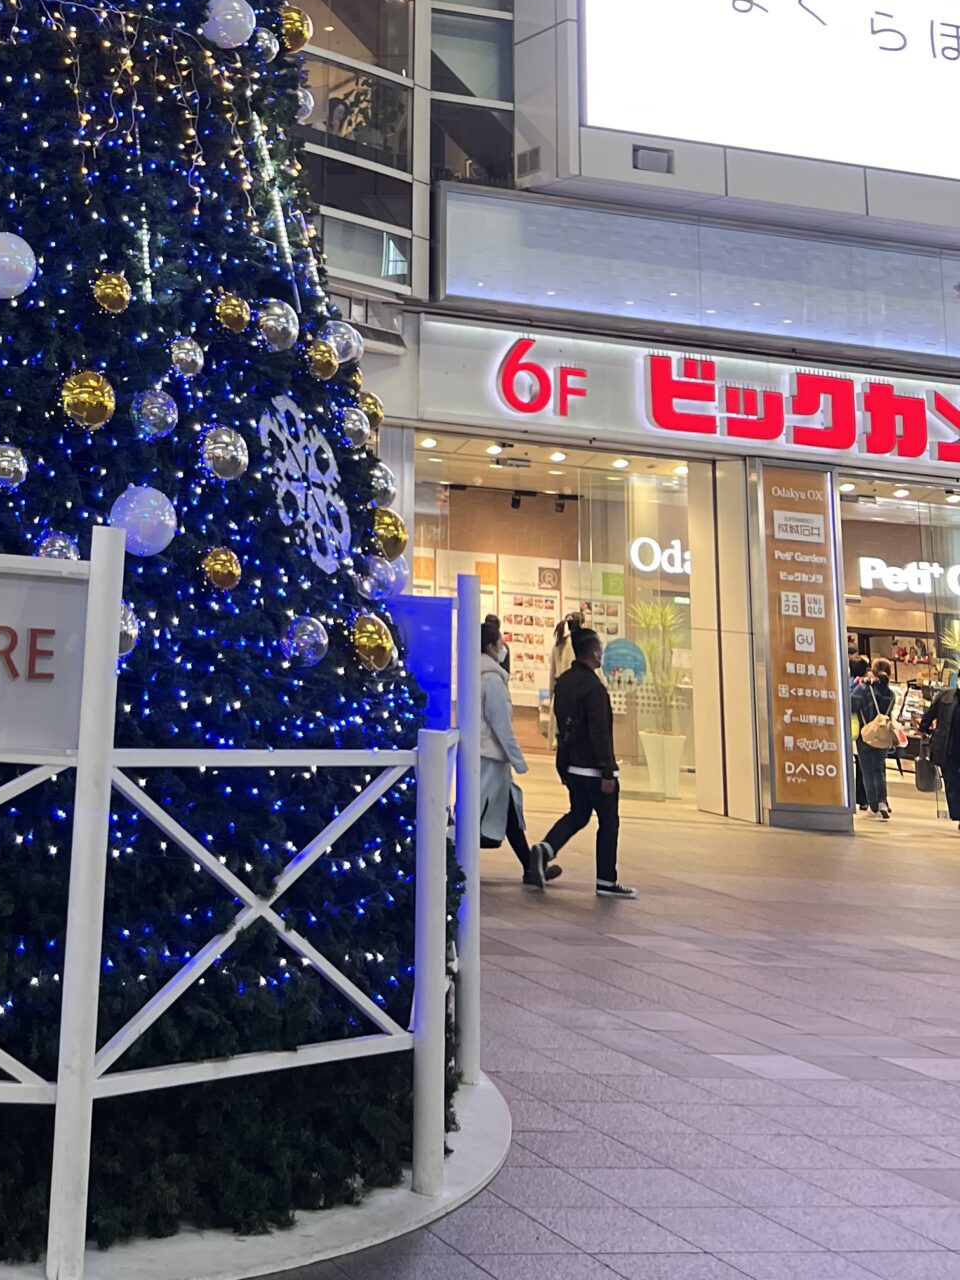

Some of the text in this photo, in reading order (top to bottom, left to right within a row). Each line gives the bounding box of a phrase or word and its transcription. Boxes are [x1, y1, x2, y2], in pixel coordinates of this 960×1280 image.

[501, 337, 588, 417] 6F
[771, 486, 823, 501] Odakyu OX
[779, 571, 823, 583] ビックカメラ
[796, 633, 813, 646] GU
[785, 762, 837, 777] DAISO
